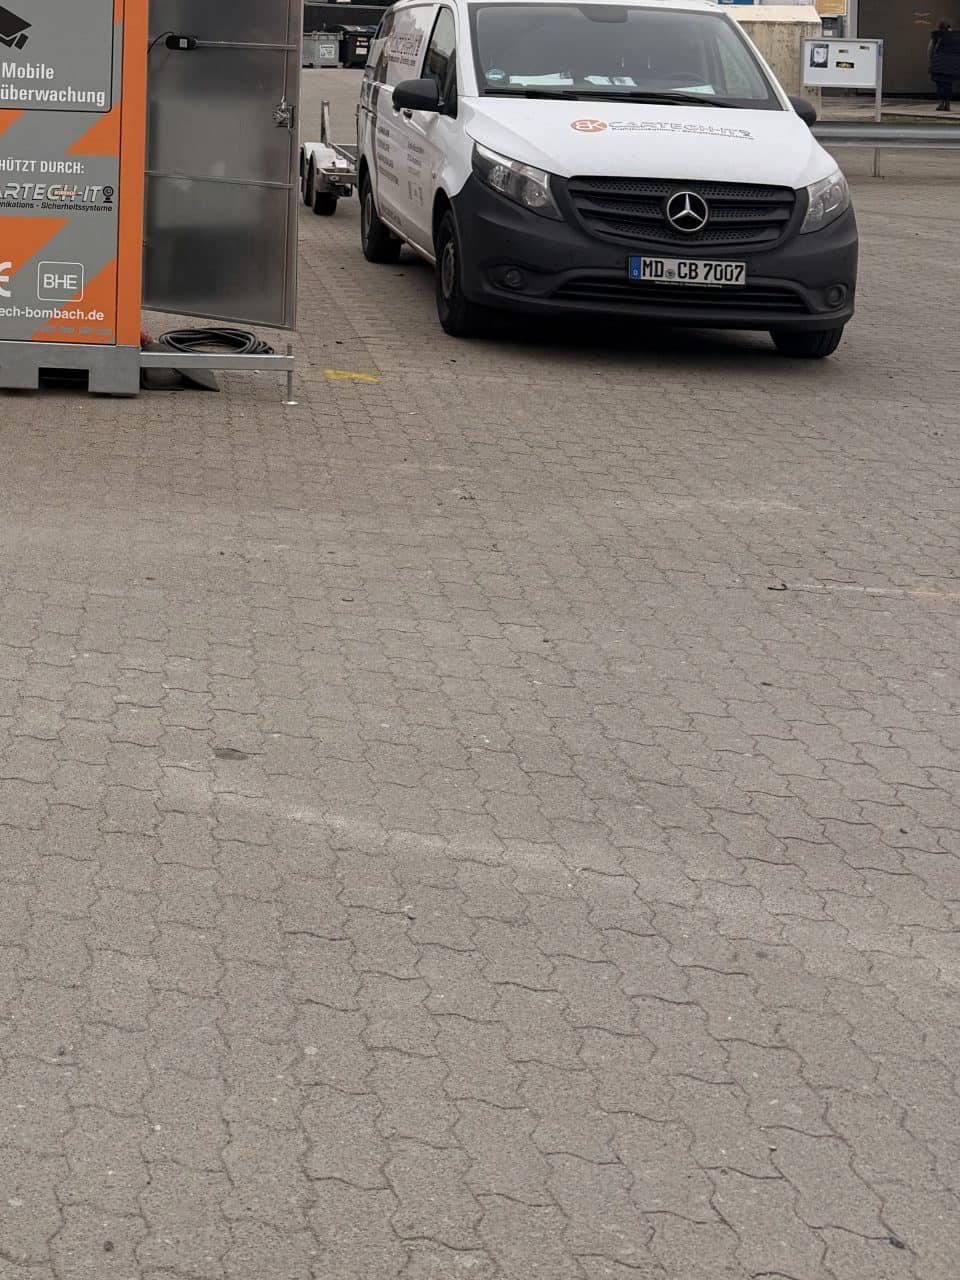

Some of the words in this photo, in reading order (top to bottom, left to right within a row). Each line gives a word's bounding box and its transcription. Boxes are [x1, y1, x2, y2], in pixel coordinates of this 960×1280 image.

[1, 62, 55, 80] Mobile
[40, 161, 85, 174] DURCH:
[41, 202, 113, 212] Sicherheitssysteme
[642, 260, 664, 278] MD
[677, 261, 699, 280] CB
[703, 263, 744, 282] 7007
[43, 273, 78, 289] BHE
